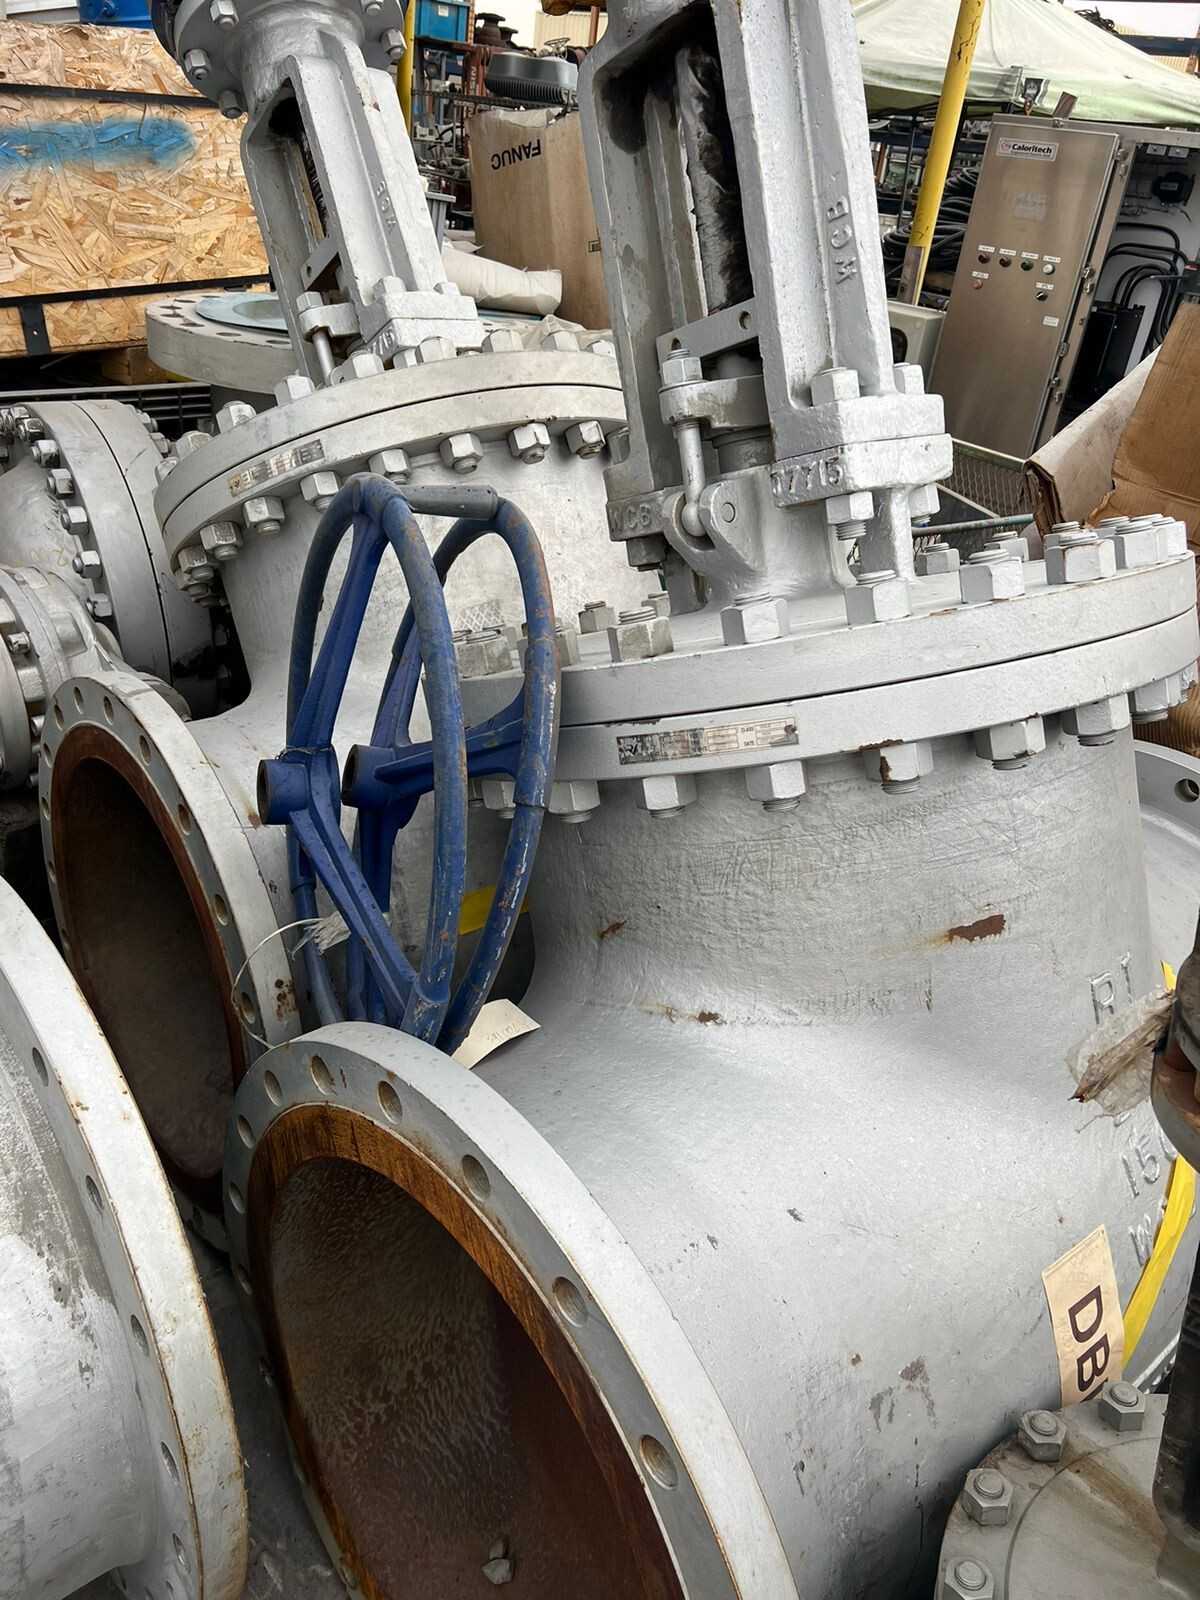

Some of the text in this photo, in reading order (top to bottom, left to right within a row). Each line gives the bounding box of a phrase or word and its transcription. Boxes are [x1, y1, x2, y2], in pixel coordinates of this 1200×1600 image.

[490, 139, 542, 171] FANUC
[1012, 143, 1053, 155] Caloritech
[1067, 1284, 1111, 1403] DB
